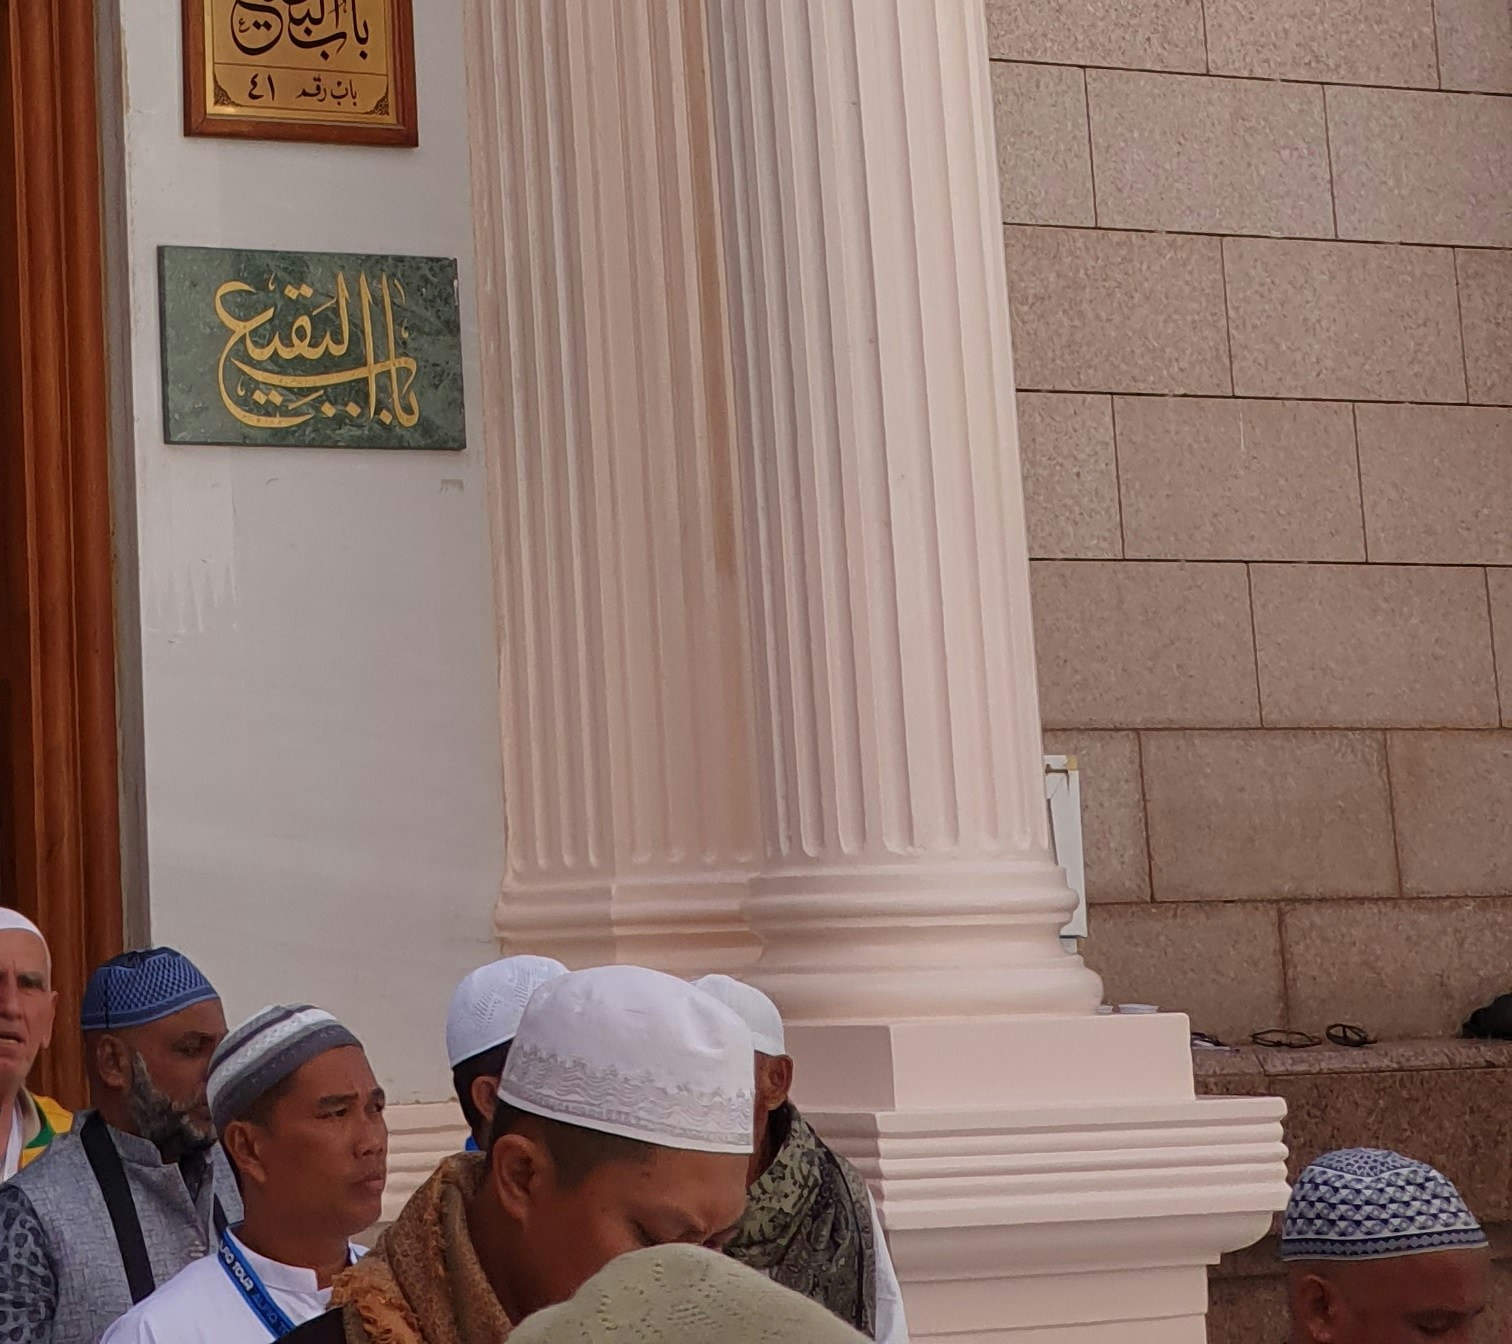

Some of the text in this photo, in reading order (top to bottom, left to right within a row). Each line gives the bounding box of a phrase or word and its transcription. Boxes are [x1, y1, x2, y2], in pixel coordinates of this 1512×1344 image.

[247, 73, 358, 107] باب رقم ٤١
[214, 271, 377, 428] البقيع
[232, 1260, 255, 1292] TOUR
